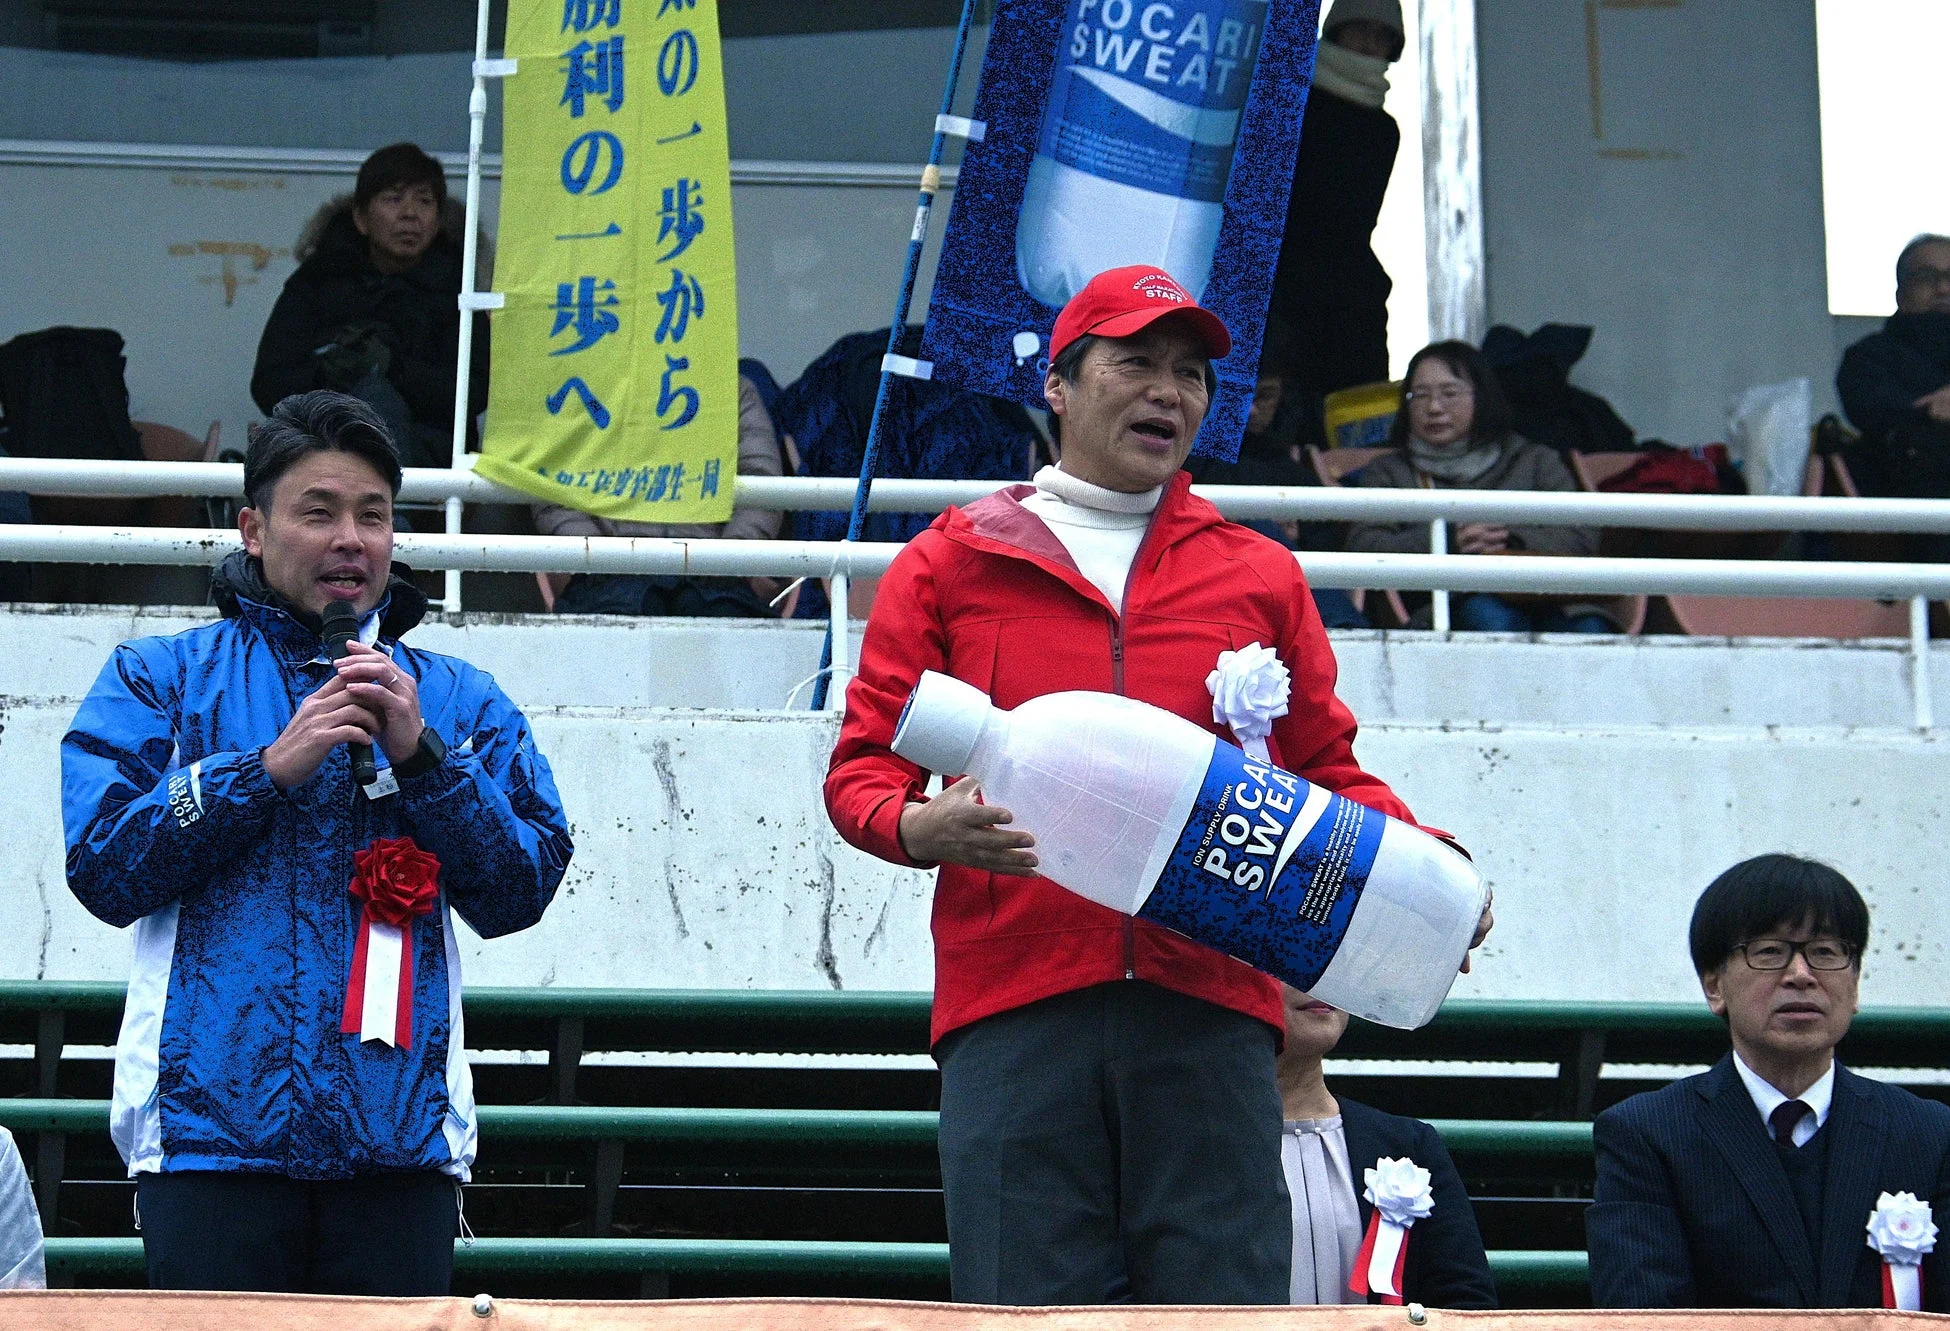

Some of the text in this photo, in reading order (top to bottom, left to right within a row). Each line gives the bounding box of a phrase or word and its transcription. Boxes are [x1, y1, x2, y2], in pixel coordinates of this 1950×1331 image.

[1070, 22, 1238, 96] SWEAT
[655, 0, 705, 430] の一歩から
[1132, 274, 1155, 290] KYOTO
[1145, 289, 1183, 304] STAFF
[168, 775, 191, 828] POCARI
[177, 775, 200, 823] SWEAT
[1193, 783, 1234, 866] ION SUPPLY DRINK
[1299, 889, 1314, 915] POCARI
[1311, 863, 1324, 888] SWEAT
[1311, 896, 1319, 908] the
[1316, 883, 1325, 896] lost
[1323, 863, 1333, 882] water
[1330, 849, 1338, 862] and
[1313, 910, 1321, 921] the
[1319, 869, 1338, 909] appropriate
[1335, 844, 1348, 868] density
[1320, 902, 1333, 925] human
[1329, 883, 1341, 901] body
